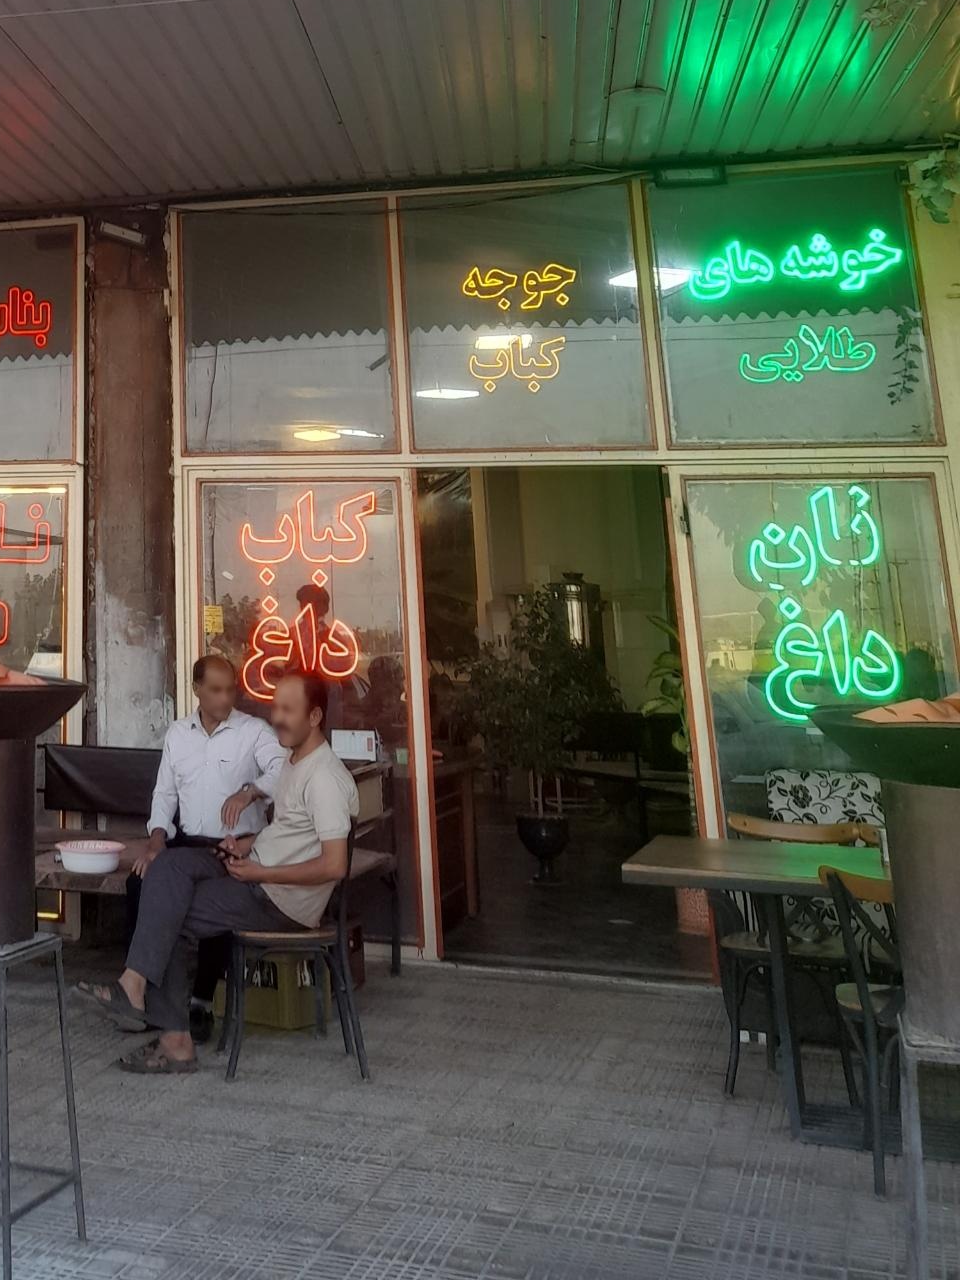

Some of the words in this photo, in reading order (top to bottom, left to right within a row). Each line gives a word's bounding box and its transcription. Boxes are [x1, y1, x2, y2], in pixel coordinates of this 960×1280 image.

[463, 263, 576, 310] جوجه
[689, 240, 775, 299] های
[781, 228, 903, 291] خوشه
[469, 335, 566, 393] کباب
[740, 324, 876, 383] طلایی
[240, 490, 375, 587] کباب
[750, 485, 879, 590] نان
[242, 595, 360, 700] داغ
[765, 596, 900, 720] داغ
